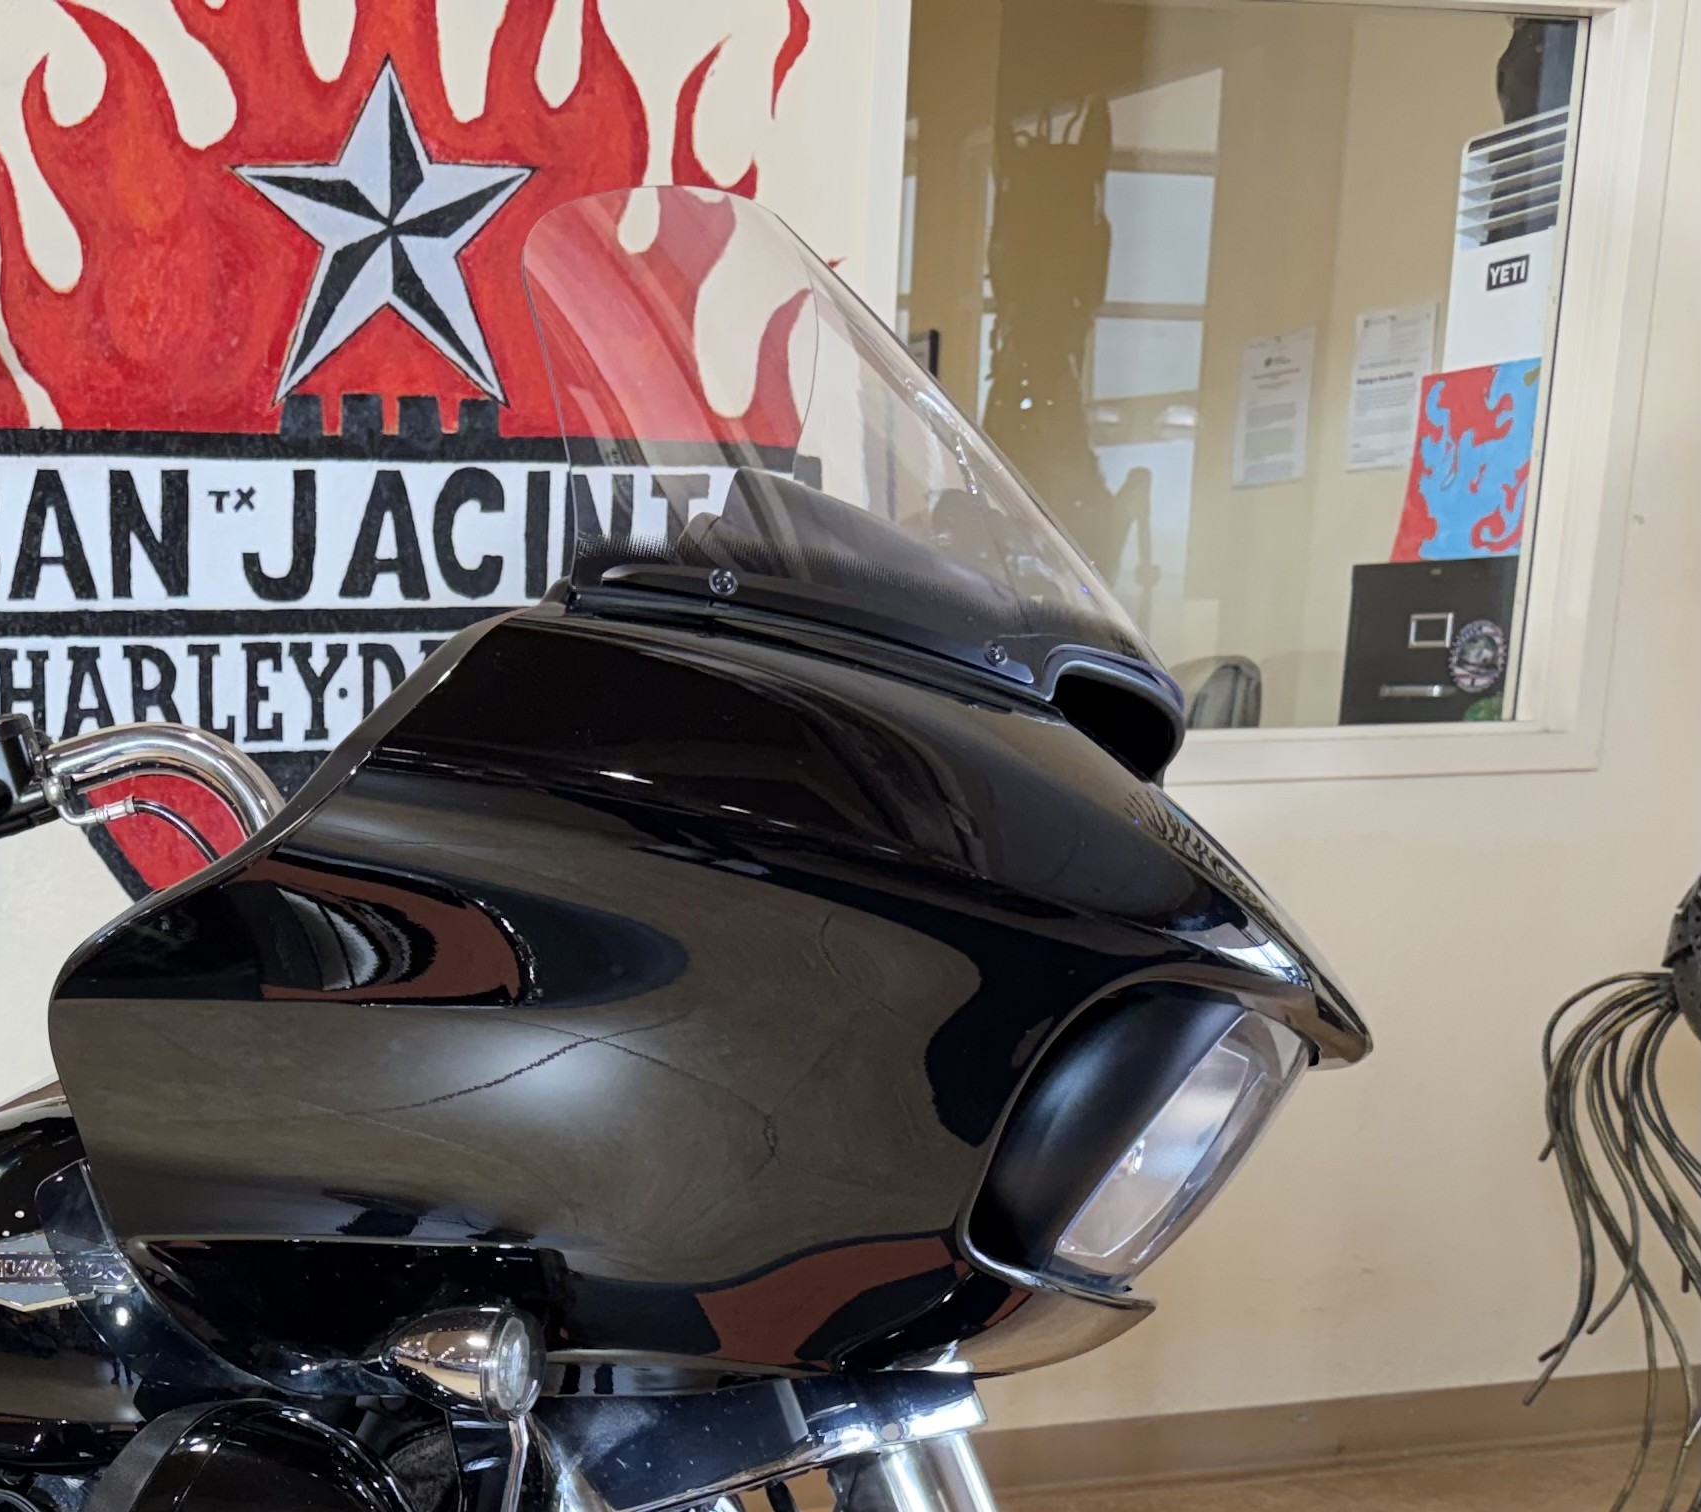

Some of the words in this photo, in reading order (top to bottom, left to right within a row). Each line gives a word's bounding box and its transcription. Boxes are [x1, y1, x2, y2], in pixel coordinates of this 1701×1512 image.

[1489, 259, 1527, 286] YETI
[208, 487, 255, 512] TX
[242, 465, 711, 601] JACINT
